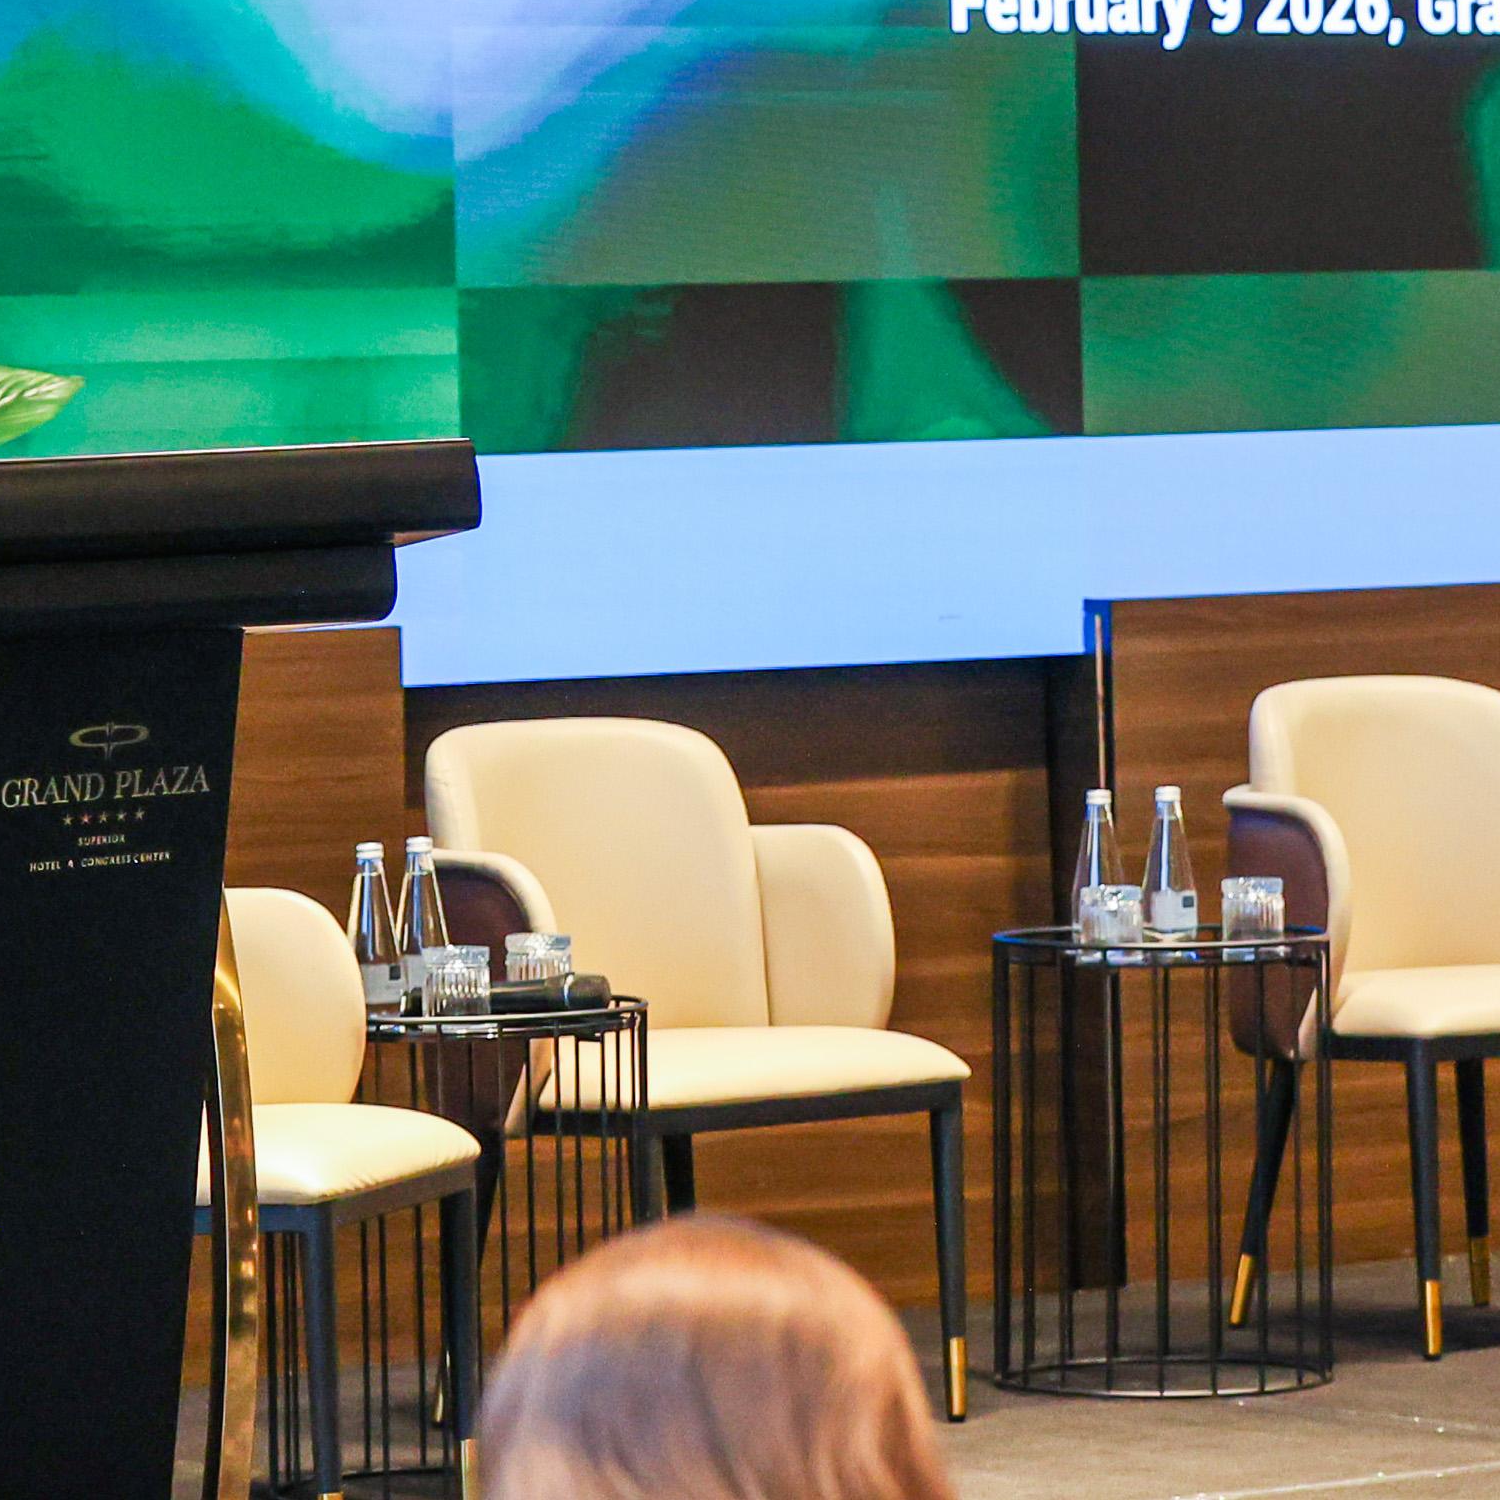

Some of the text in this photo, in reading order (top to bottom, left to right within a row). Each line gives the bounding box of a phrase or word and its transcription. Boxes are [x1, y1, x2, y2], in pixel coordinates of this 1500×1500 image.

[1, 764, 210, 808] GRAND PLAZA
[29, 861, 61, 872] HOTEL
